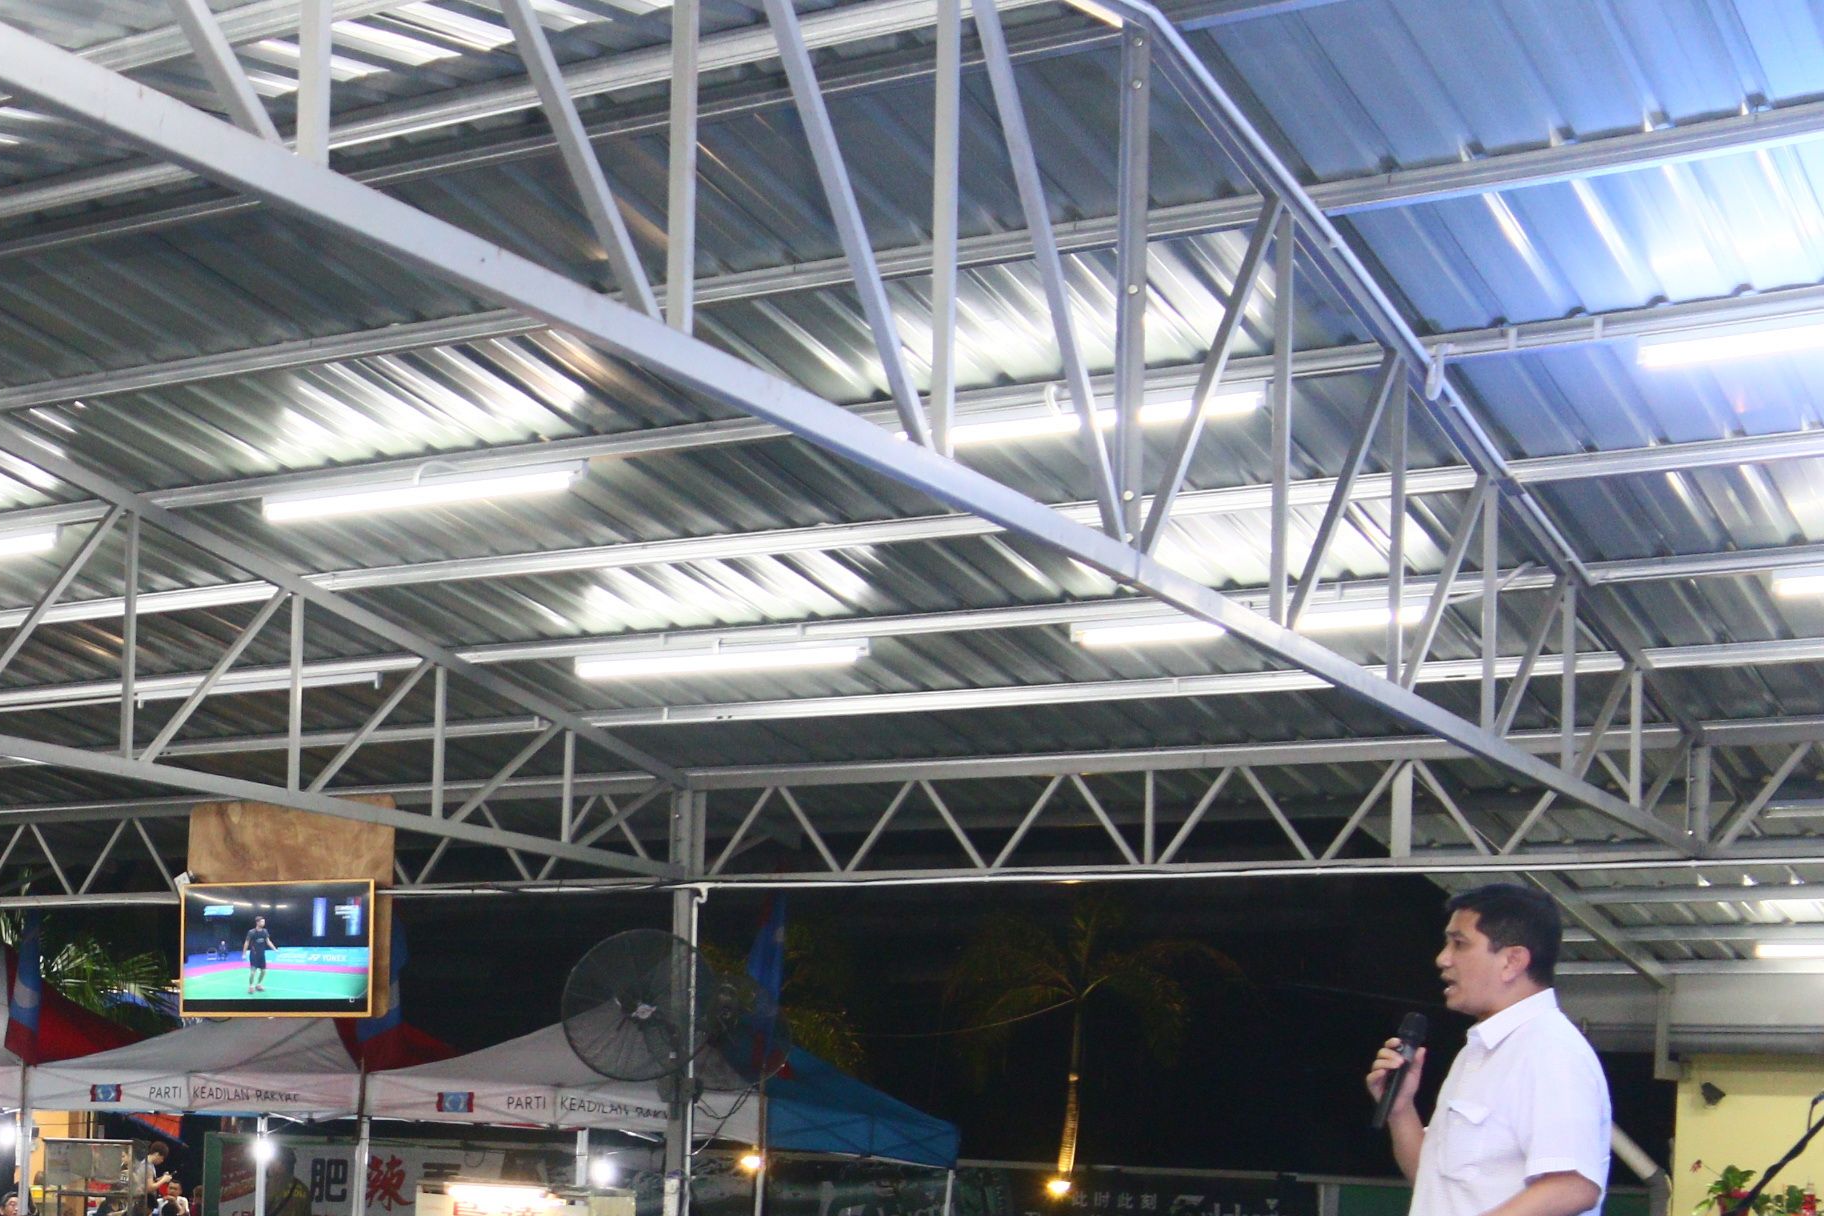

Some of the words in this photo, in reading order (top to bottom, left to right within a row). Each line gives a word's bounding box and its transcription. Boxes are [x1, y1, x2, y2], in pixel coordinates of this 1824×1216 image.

[149, 1086, 182, 1100] PARTI
[192, 1086, 250, 1101] KEADILAN
[507, 1096, 546, 1110] PARTI
[560, 1096, 629, 1116] KEADILAN
